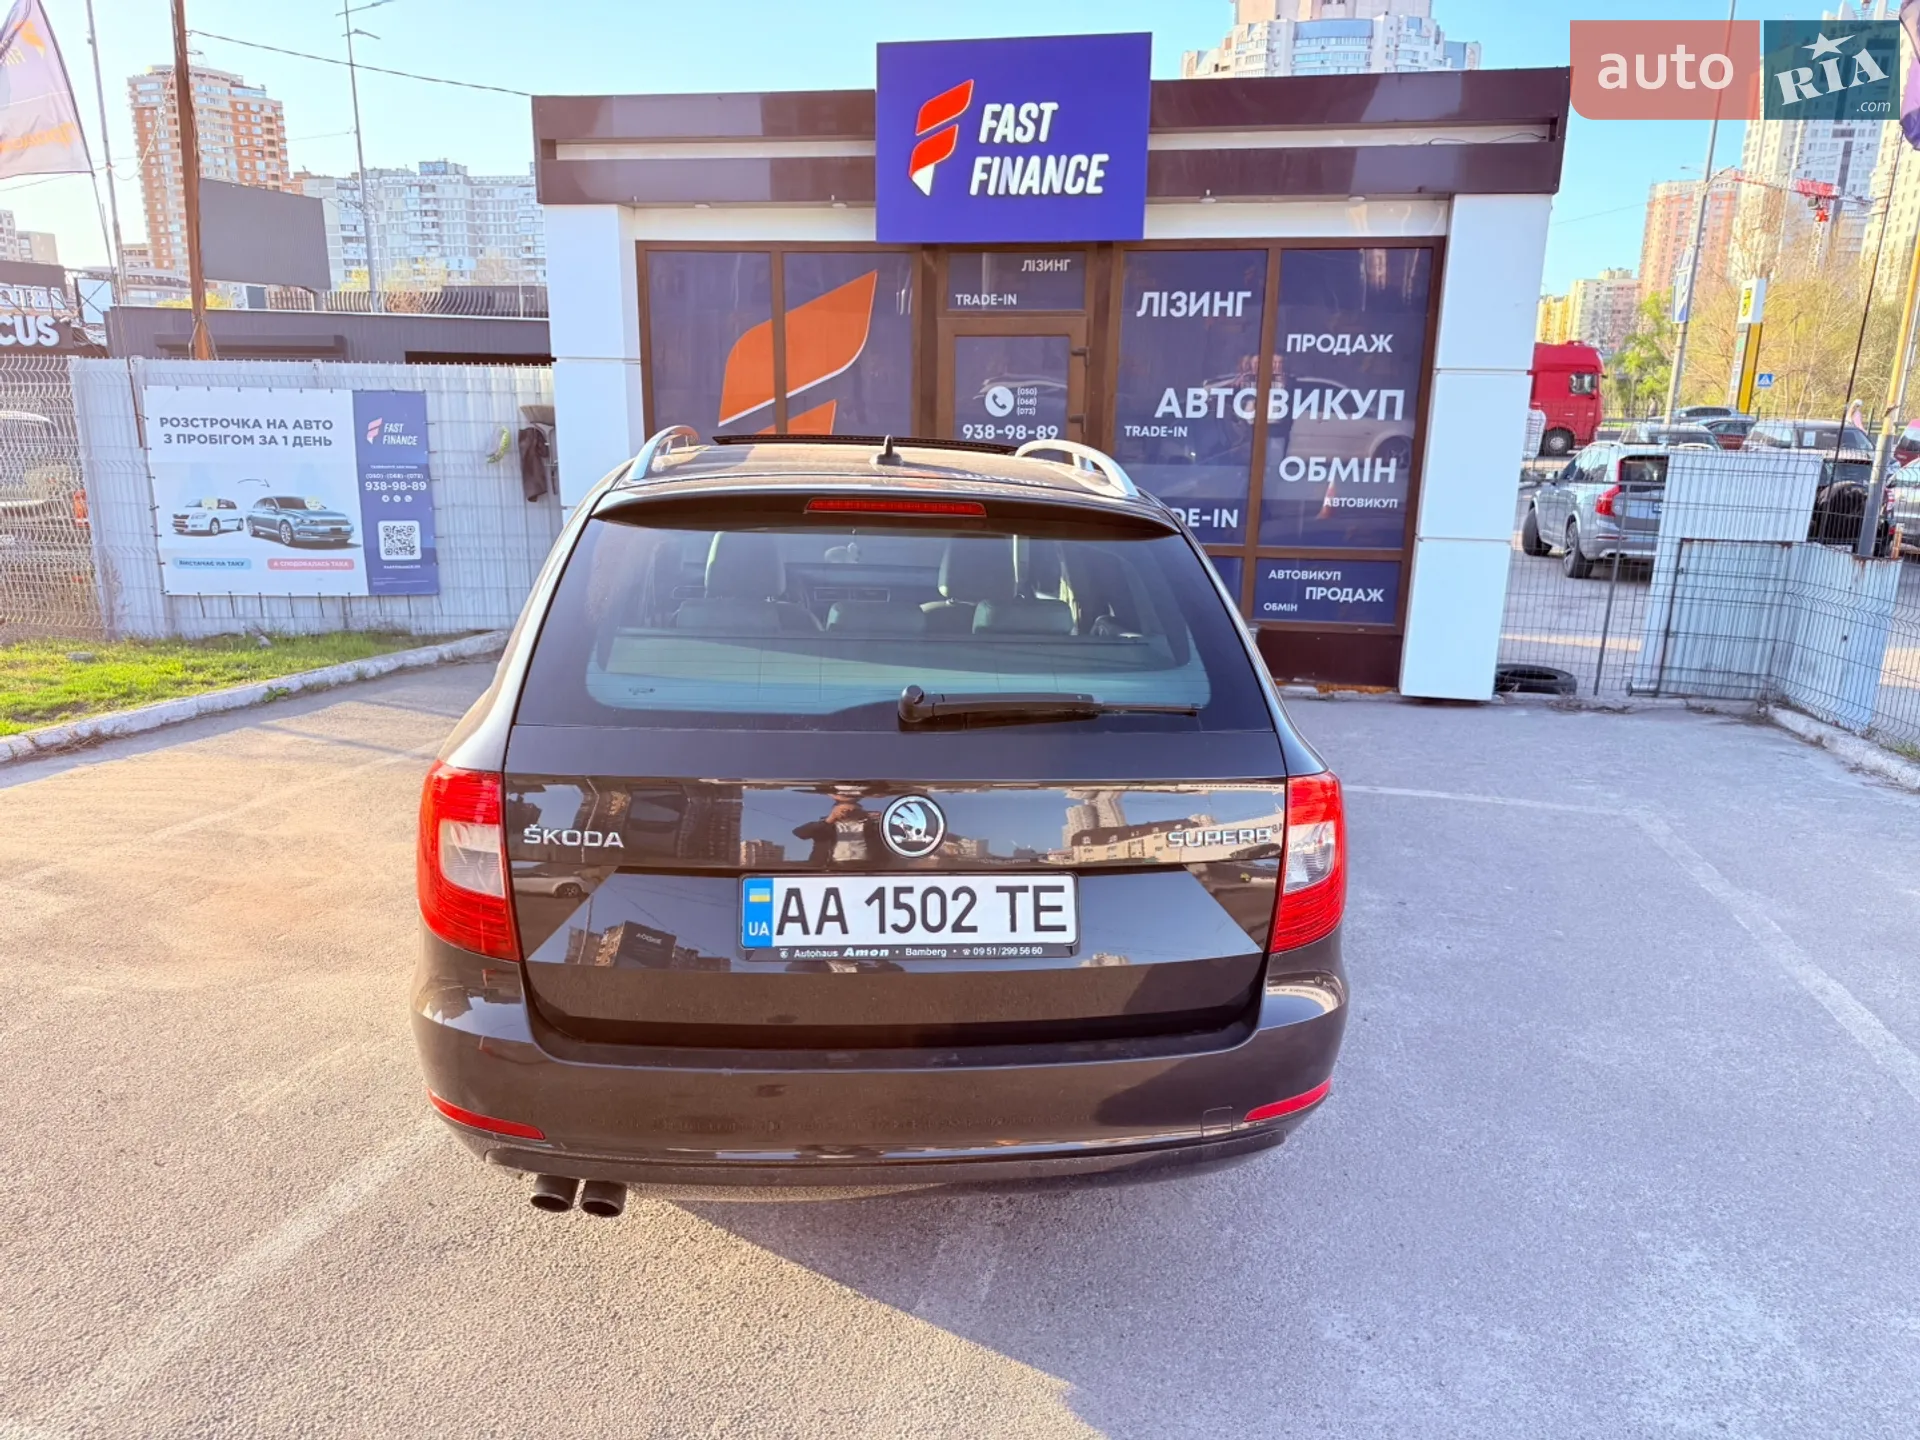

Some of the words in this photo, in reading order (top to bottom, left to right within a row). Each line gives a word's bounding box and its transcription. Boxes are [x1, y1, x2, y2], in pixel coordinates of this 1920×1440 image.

[978, 102, 1059, 144] FAST
[969, 153, 1109, 196] FINANCE
[1021, 259, 1071, 272] ЛІЗИНГ
[955, 294, 1017, 306] TRADE-IN
[1136, 291, 1252, 318] ЛІЗИНГ
[1286, 333, 1394, 356] ПРОДАЖ
[1017, 387, 1037, 396] (050)
[1017, 396, 1037, 406] (068)
[1154, 387, 1405, 421] АВТОВИКУП
[1016, 407, 1036, 416] (073)
[159, 417, 262, 430] РОЗСТРОЧКА
[266, 419, 288, 430] НА
[292, 419, 334, 431] АВТО
[384, 422, 405, 433] FAST
[962, 423, 1059, 441] 938-98-89
[1124, 426, 1188, 438] TRADE-IN
[176, 434, 255, 446] ПРОБІГОМ
[259, 434, 279, 446] ЗА
[282, 435, 288, 446] 1
[292, 436, 333, 448] ДЕНЬ
[382, 435, 418, 446] FINANCE
[1278, 455, 1398, 483] ОБМІН
[365, 481, 427, 491] 938-98-89
[1323, 497, 1398, 509] АВТОВИКУП
[1268, 569, 1342, 581] АВТОВИКУП
[1305, 587, 1385, 604] ПРОДАЖ
[1263, 602, 1298, 612] ОБМІН
[523, 823, 625, 849] ŠKODA
[1167, 827, 1272, 848] SUPERB
[776, 886, 850, 936] AA
[864, 885, 978, 935] 1502
[996, 885, 1067, 933] TE
[748, 921, 770, 936] UA
[794, 949, 839, 958] Autohaus
[843, 947, 890, 957] Amon
[905, 947, 947, 958] Bamberg
